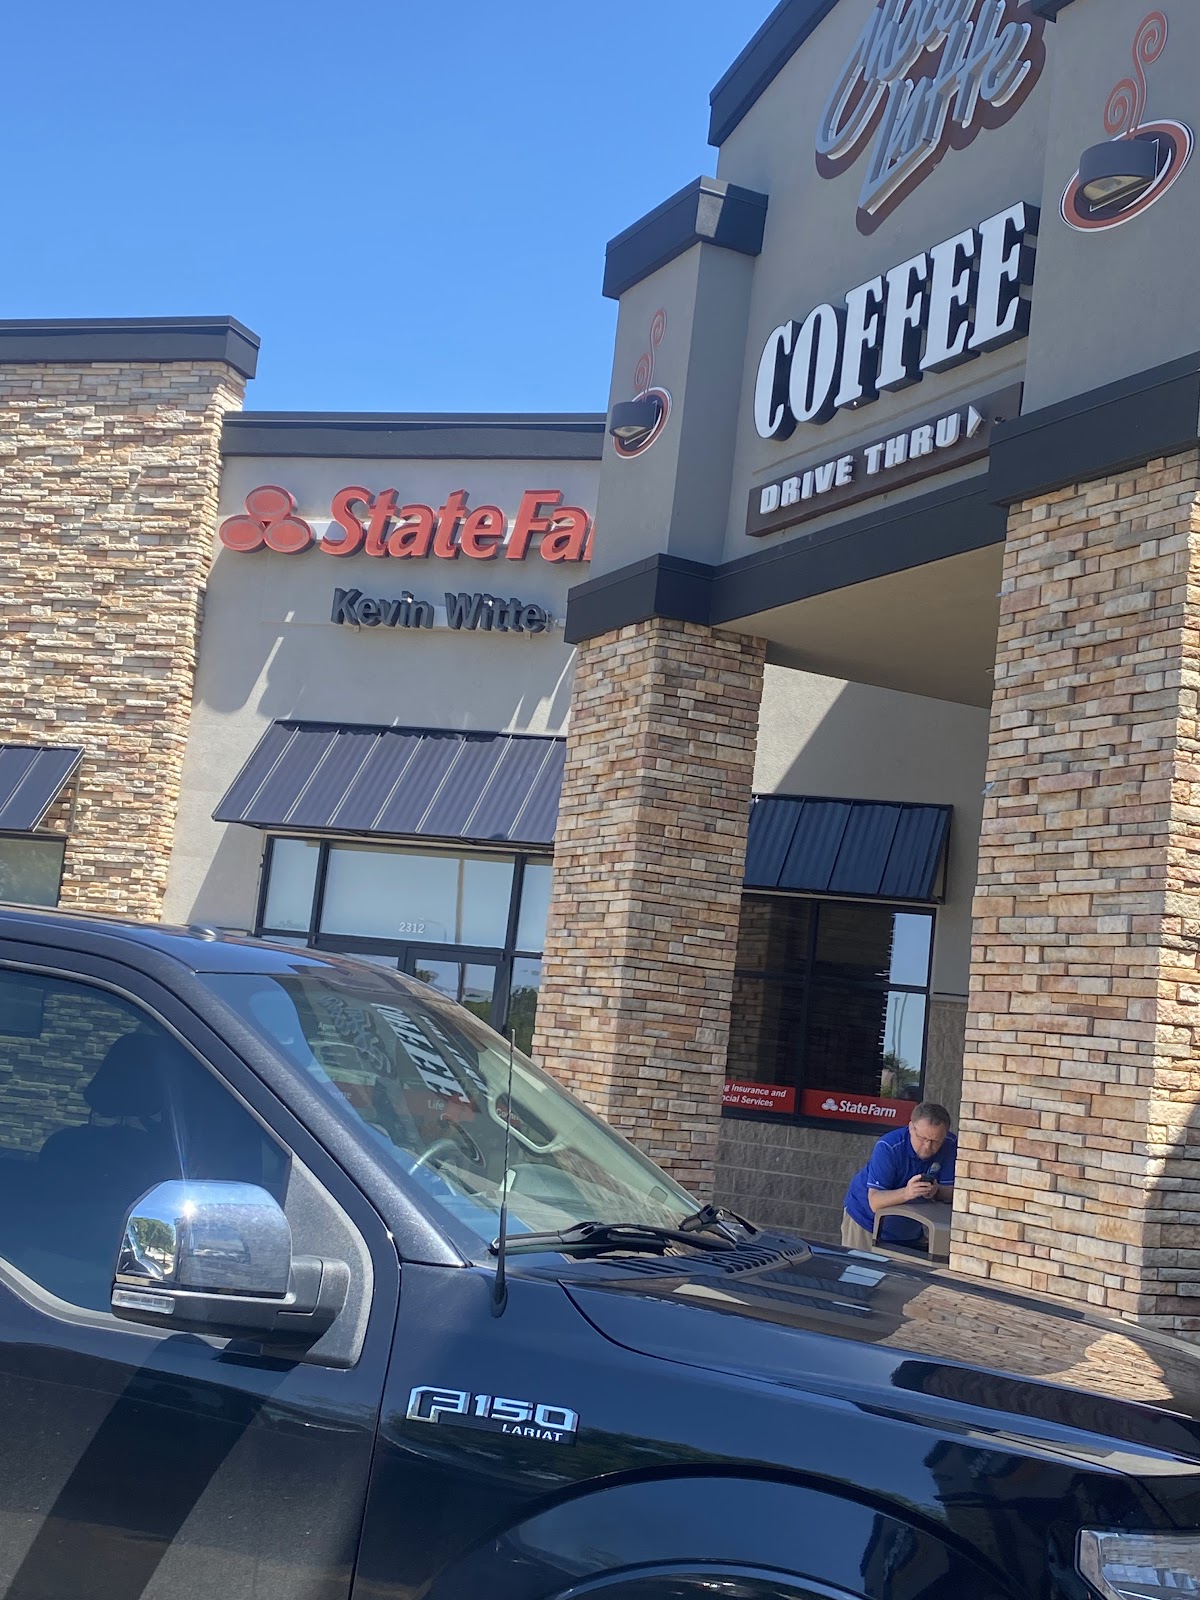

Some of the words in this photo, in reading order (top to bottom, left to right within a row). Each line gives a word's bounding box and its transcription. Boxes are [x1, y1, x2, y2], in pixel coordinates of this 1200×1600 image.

[754, 201, 1038, 441] COFFEE
[759, 454, 854, 515] DRIVE
[864, 413, 960, 475] THRU
[330, 587, 435, 629] Kevin
[444, 592, 553, 633] Witte
[399, 921, 425, 934] 2312
[731, 1083, 770, 1096] Insurance
[770, 1089, 787, 1098] and
[427, 1099, 445, 1111] Life
[740, 1095, 774, 1107] Services
[502, 1423, 564, 1442] LARIAT
